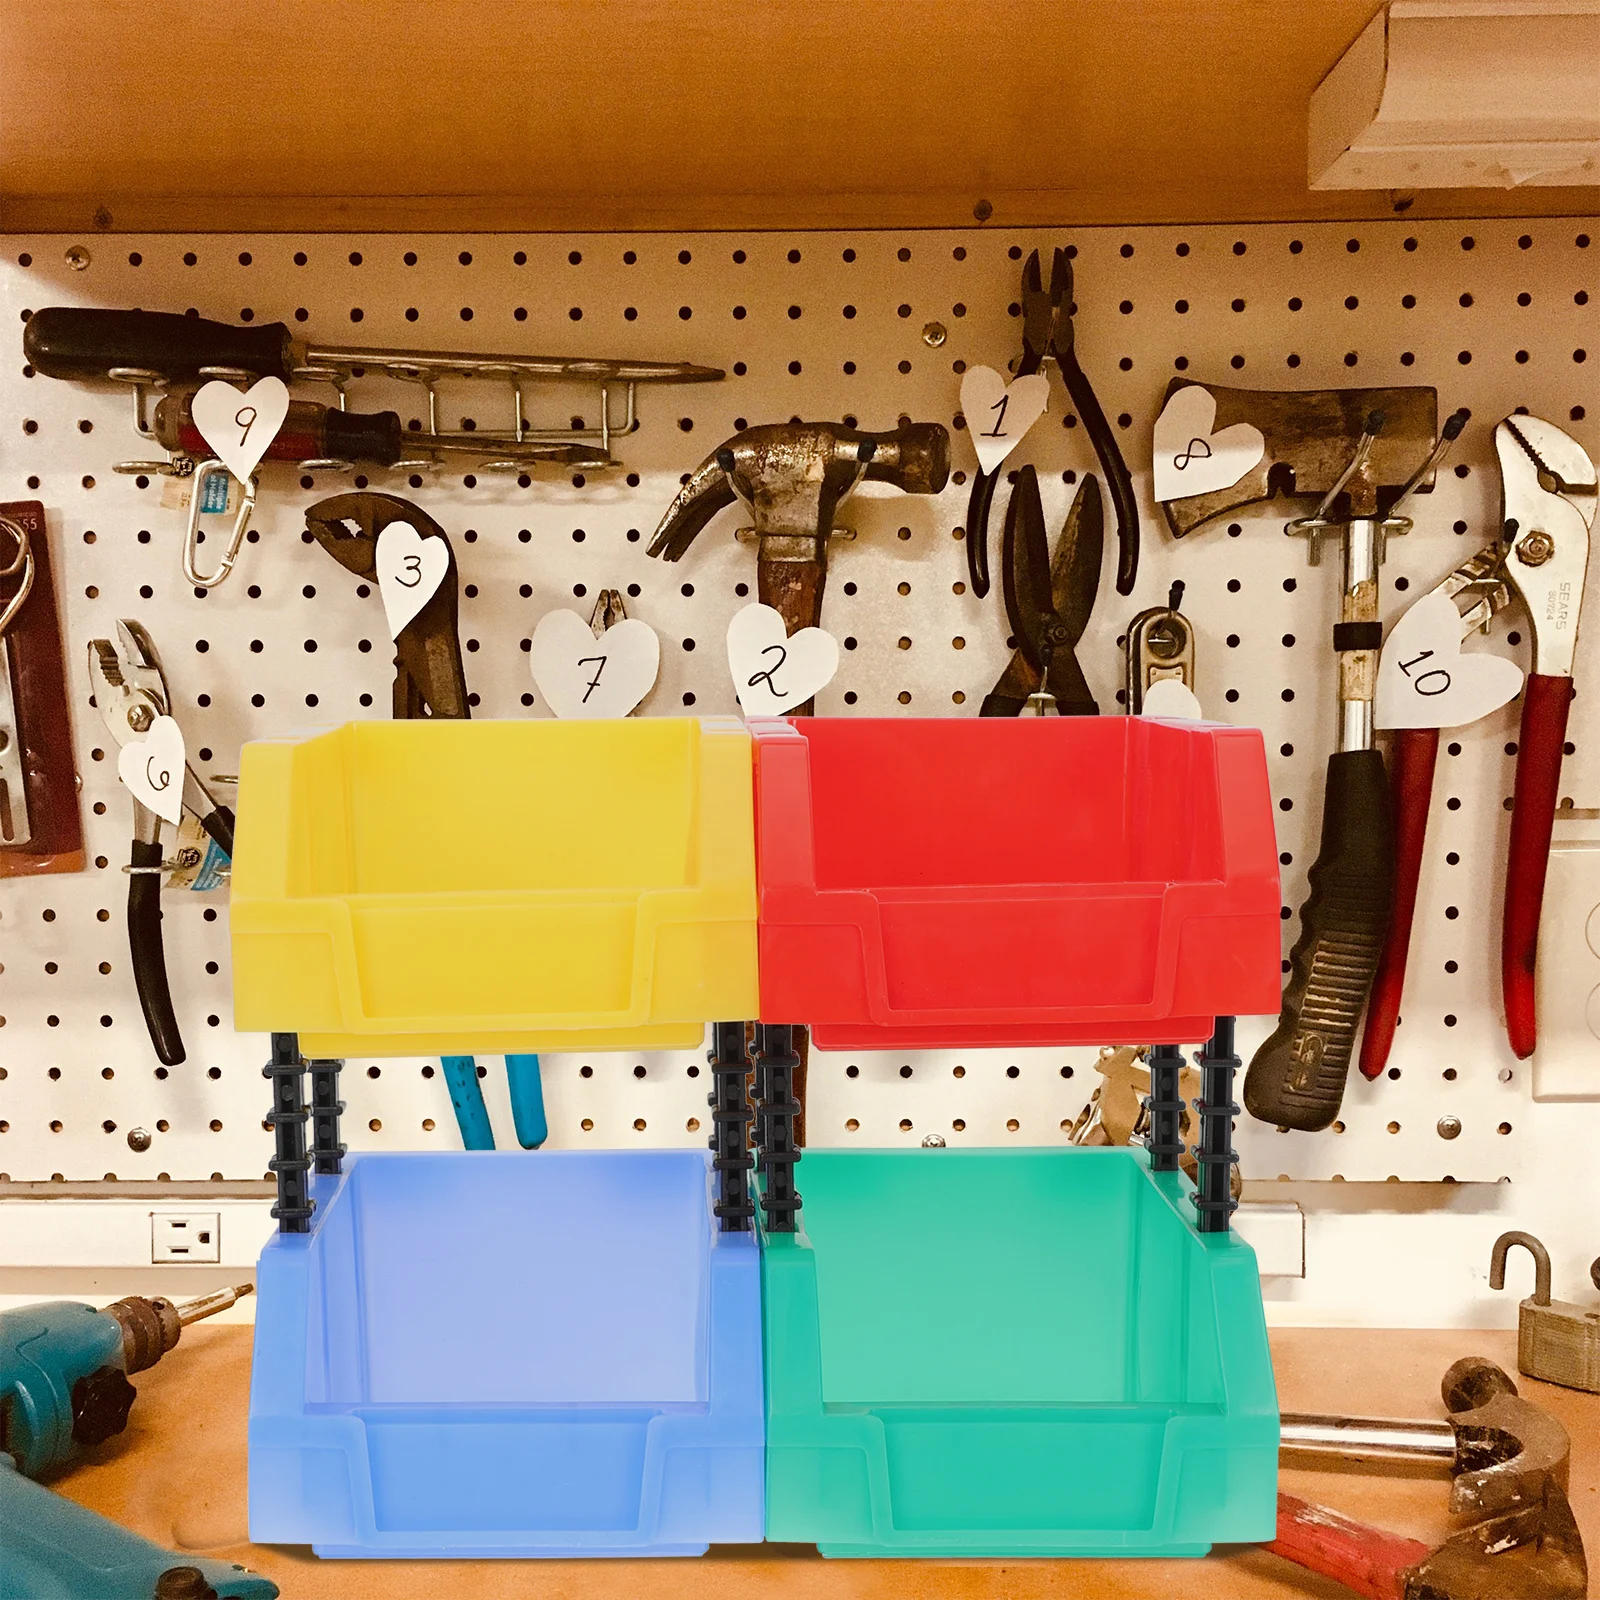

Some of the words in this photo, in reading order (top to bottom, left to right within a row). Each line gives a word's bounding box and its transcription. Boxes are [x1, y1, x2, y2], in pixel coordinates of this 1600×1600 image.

[234, 406, 258, 448] 9
[979, 394, 1010, 438] 1
[1173, 437, 1213, 471] 8
[394, 555, 422, 589] 3
[1555, 582, 1571, 630] SEARS
[577, 655, 608, 704] 7
[747, 644, 789, 698] 2
[1397, 649, 1452, 697] 10
[146, 755, 170, 792] 6
